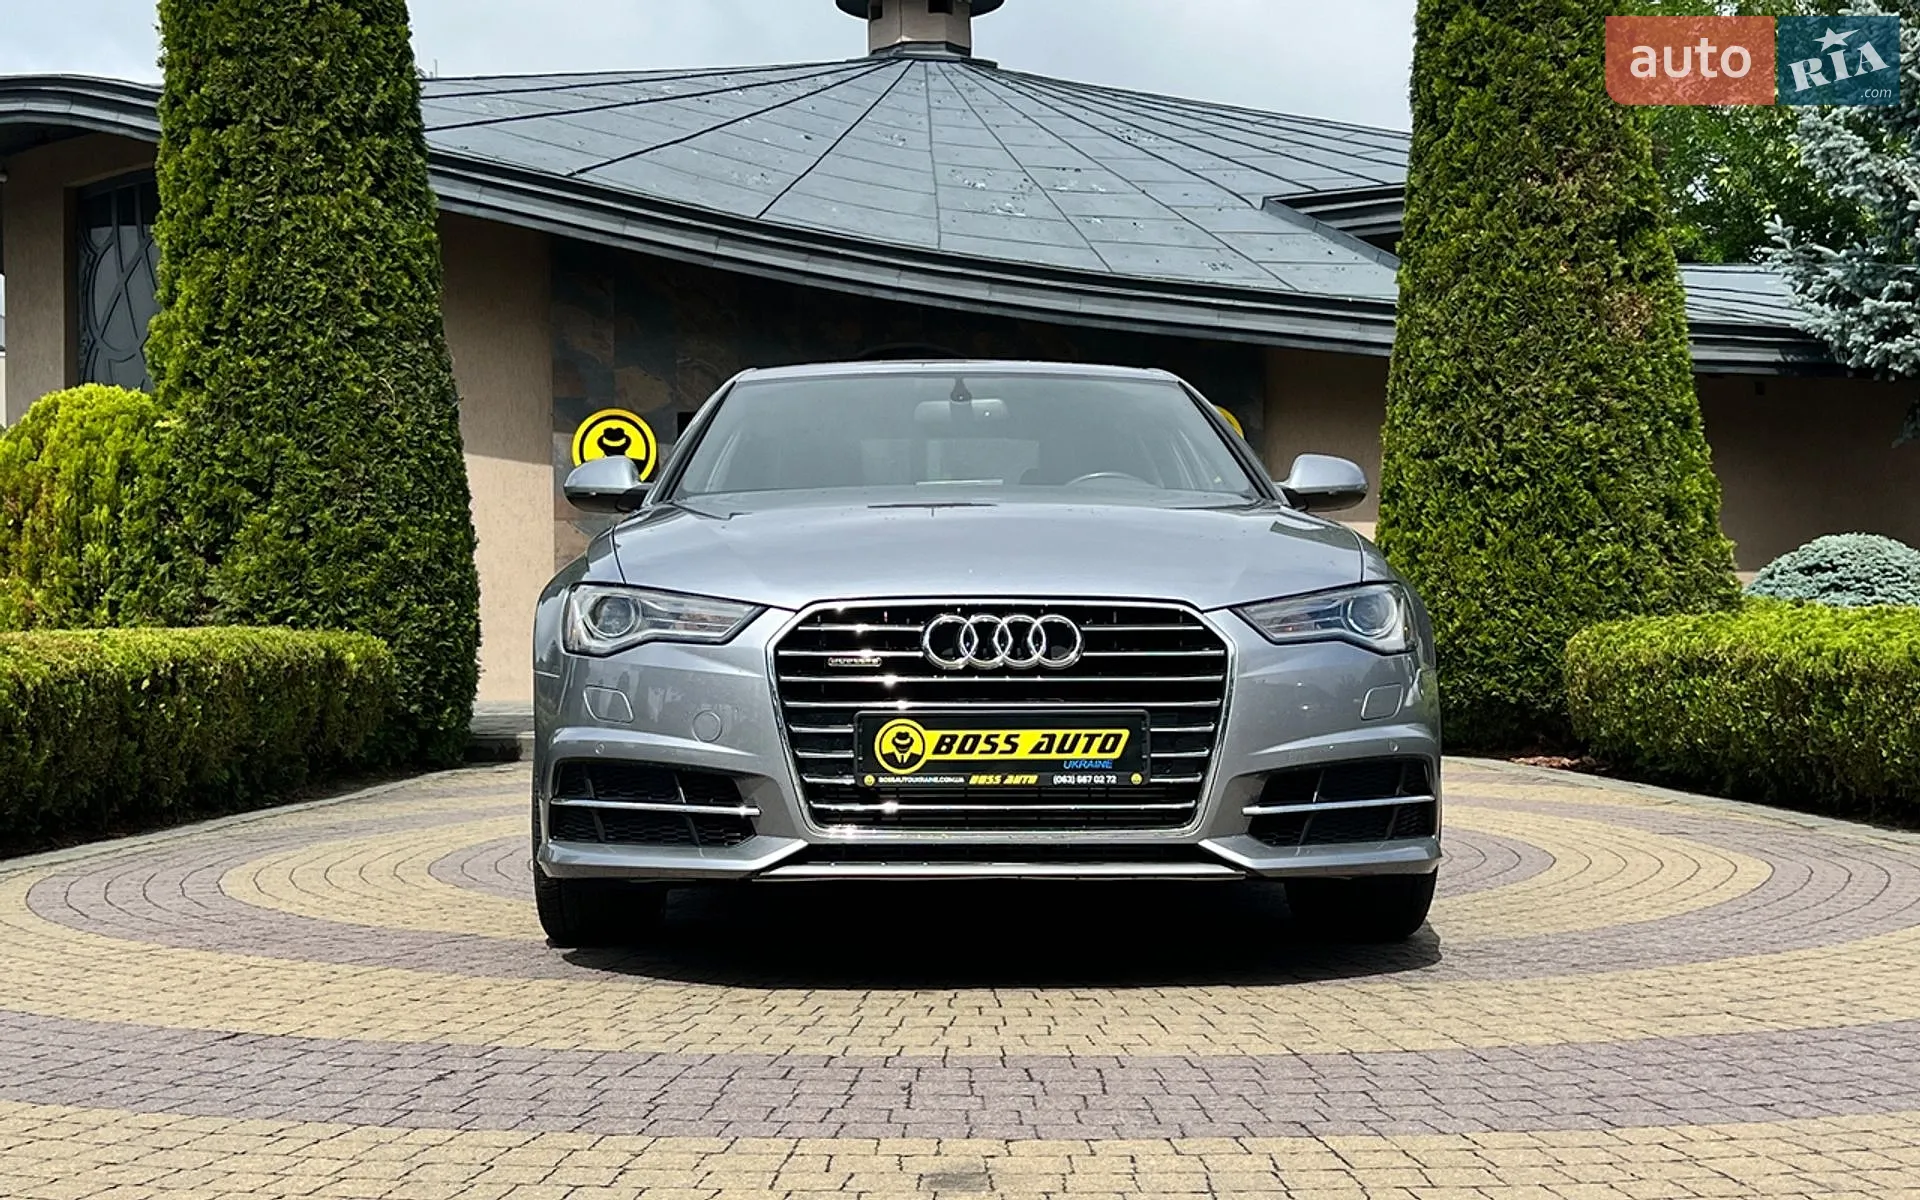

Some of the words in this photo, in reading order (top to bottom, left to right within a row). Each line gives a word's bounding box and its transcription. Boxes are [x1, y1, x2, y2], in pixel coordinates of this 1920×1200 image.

[932, 733, 1020, 755] BOSS
[1028, 733, 1124, 755] AUTO
[1063, 759, 1113, 769] UKRAINE
[969, 775, 1001, 784] BOSS
[1004, 775, 1038, 784] AUTO
